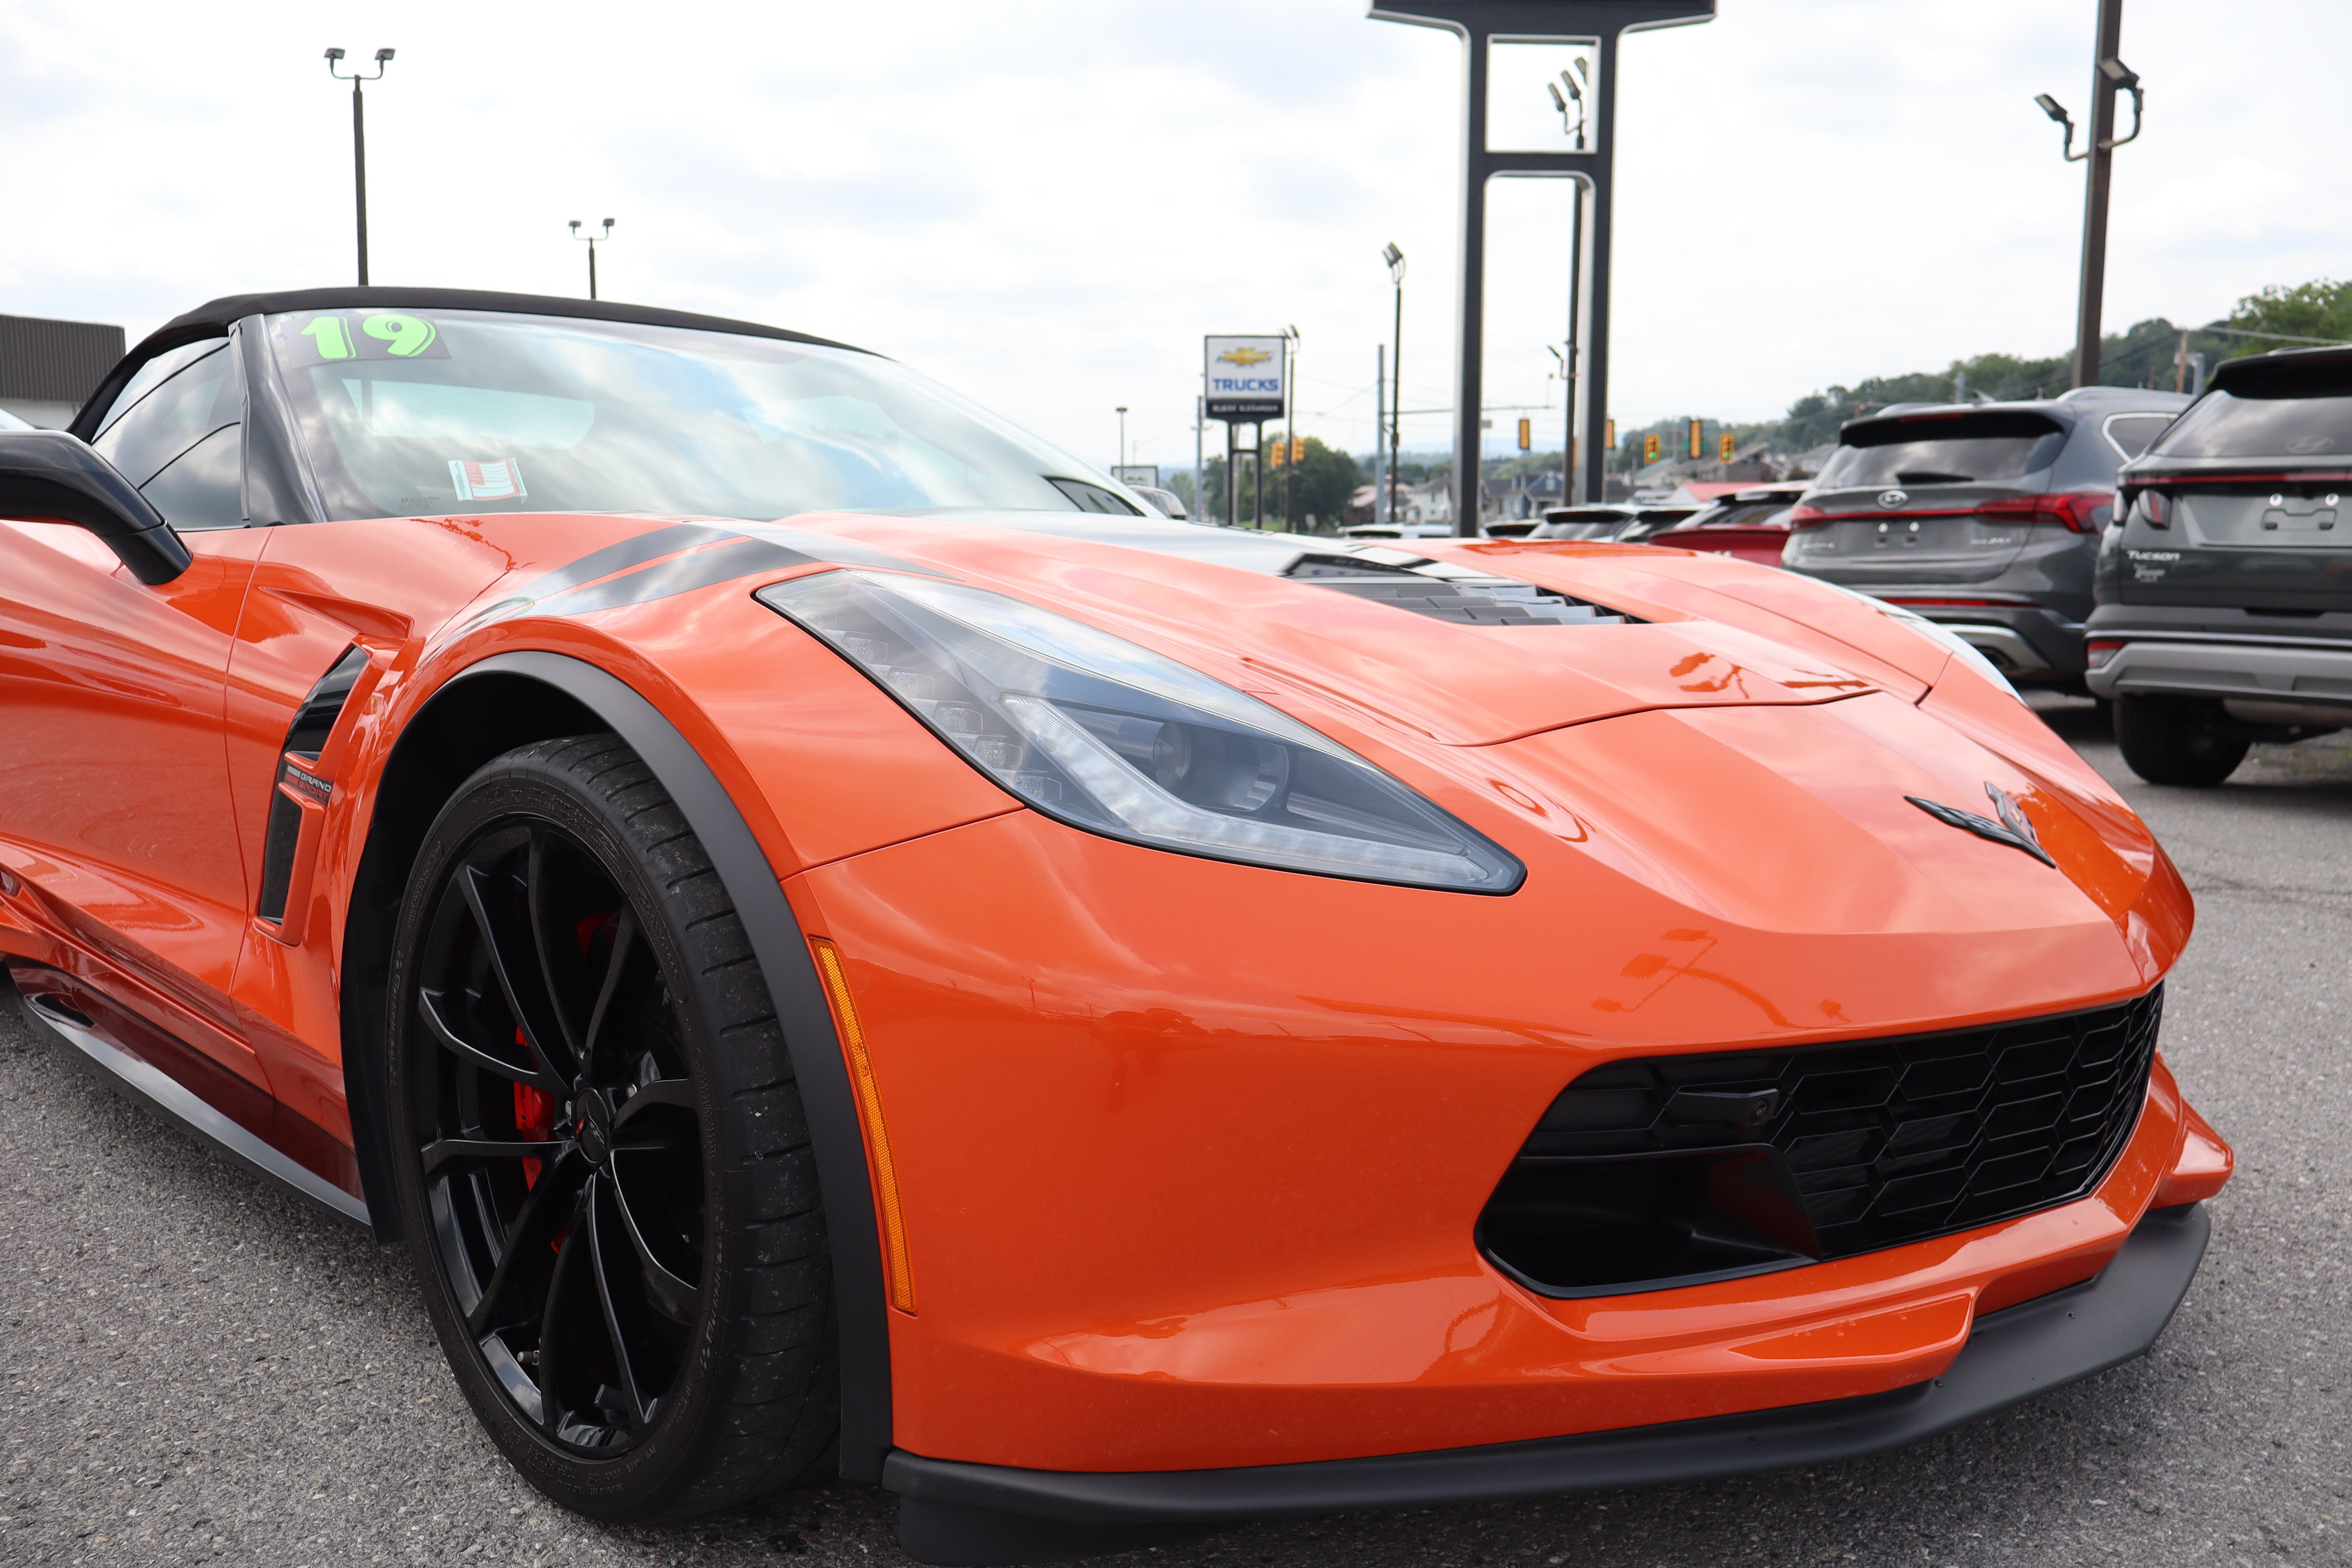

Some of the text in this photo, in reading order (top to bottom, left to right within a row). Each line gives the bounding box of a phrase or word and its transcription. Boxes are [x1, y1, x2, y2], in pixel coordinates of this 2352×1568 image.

[301, 314, 436, 359] 19
[1212, 378, 1278, 391] TRUCKS
[298, 780, 330, 799] SPORT
[300, 772, 332, 792] GRAND
